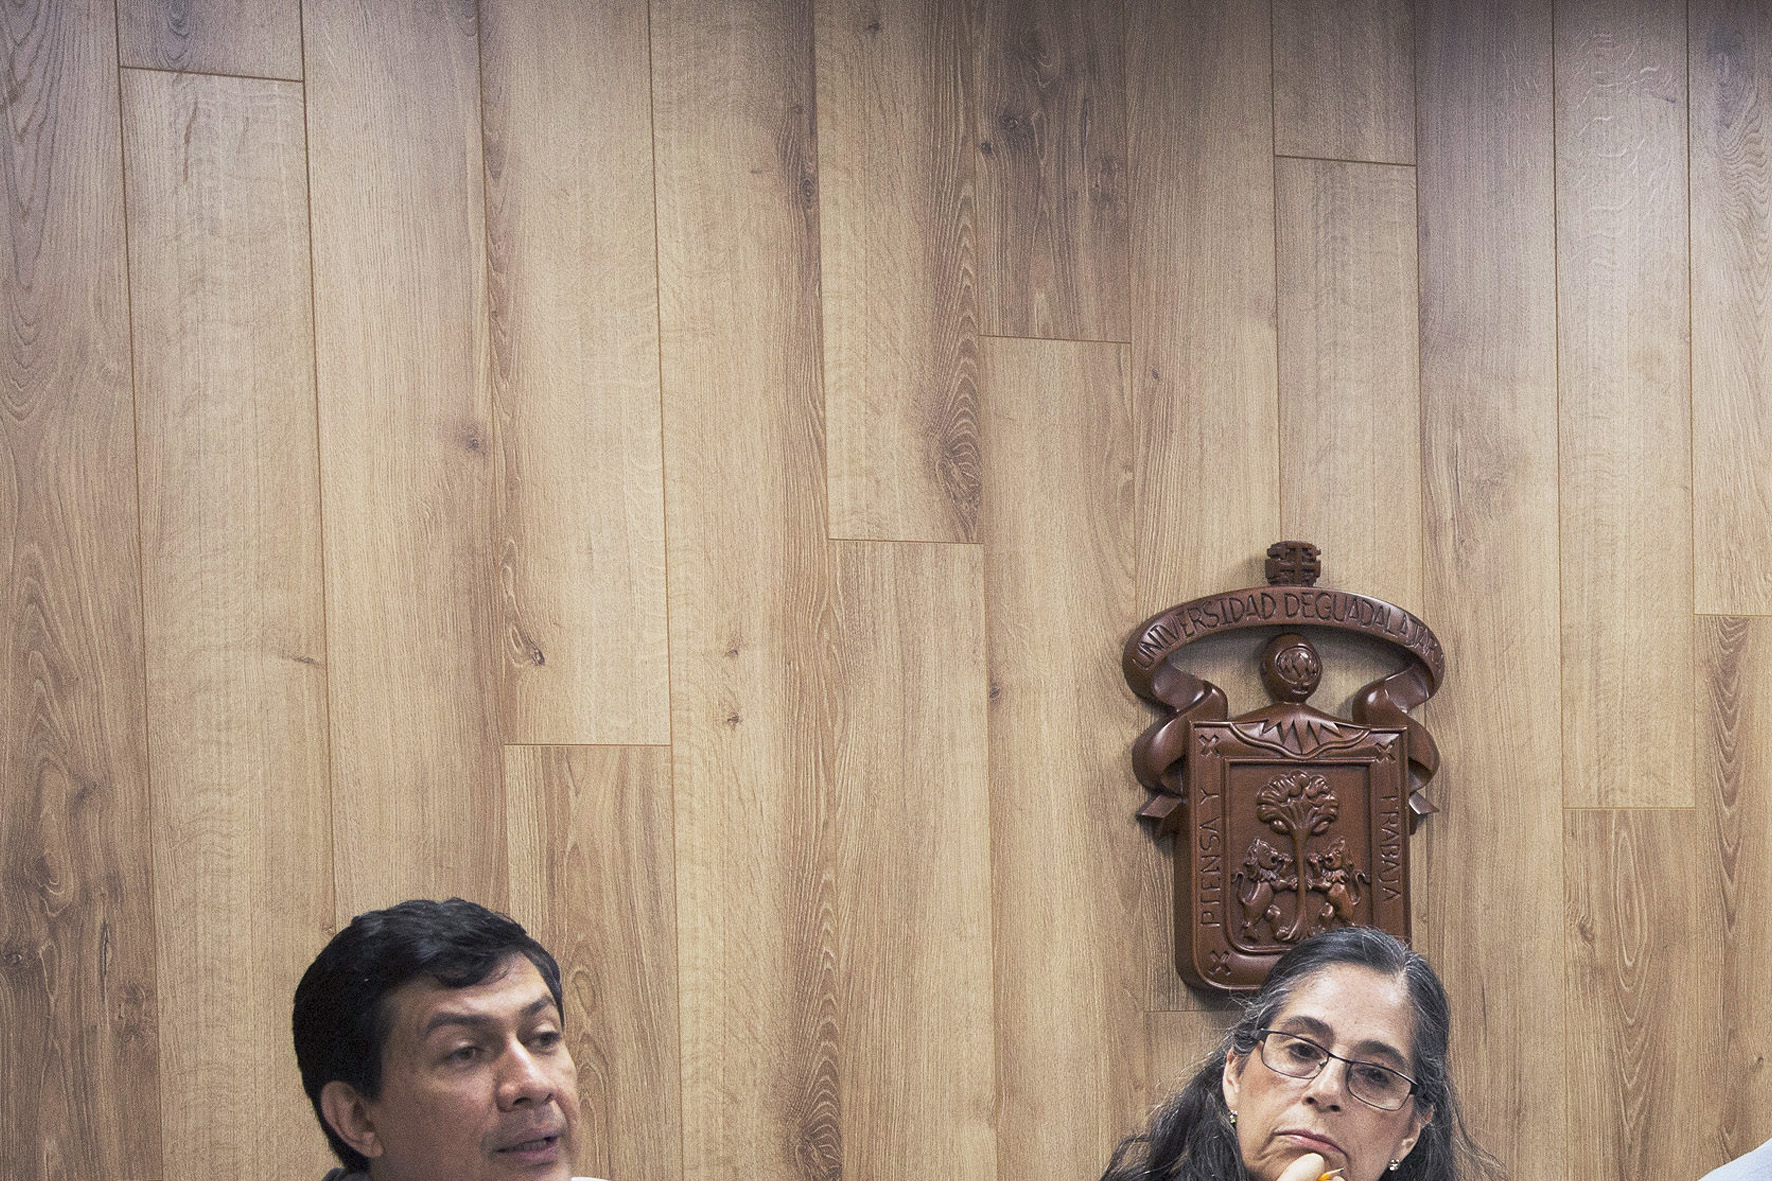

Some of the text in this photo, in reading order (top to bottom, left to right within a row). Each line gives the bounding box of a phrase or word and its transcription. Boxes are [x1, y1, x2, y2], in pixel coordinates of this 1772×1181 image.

[1131, 592, 1277, 671] UNIVERSIDAD
[1199, 787, 1222, 928] PIENSA Y
